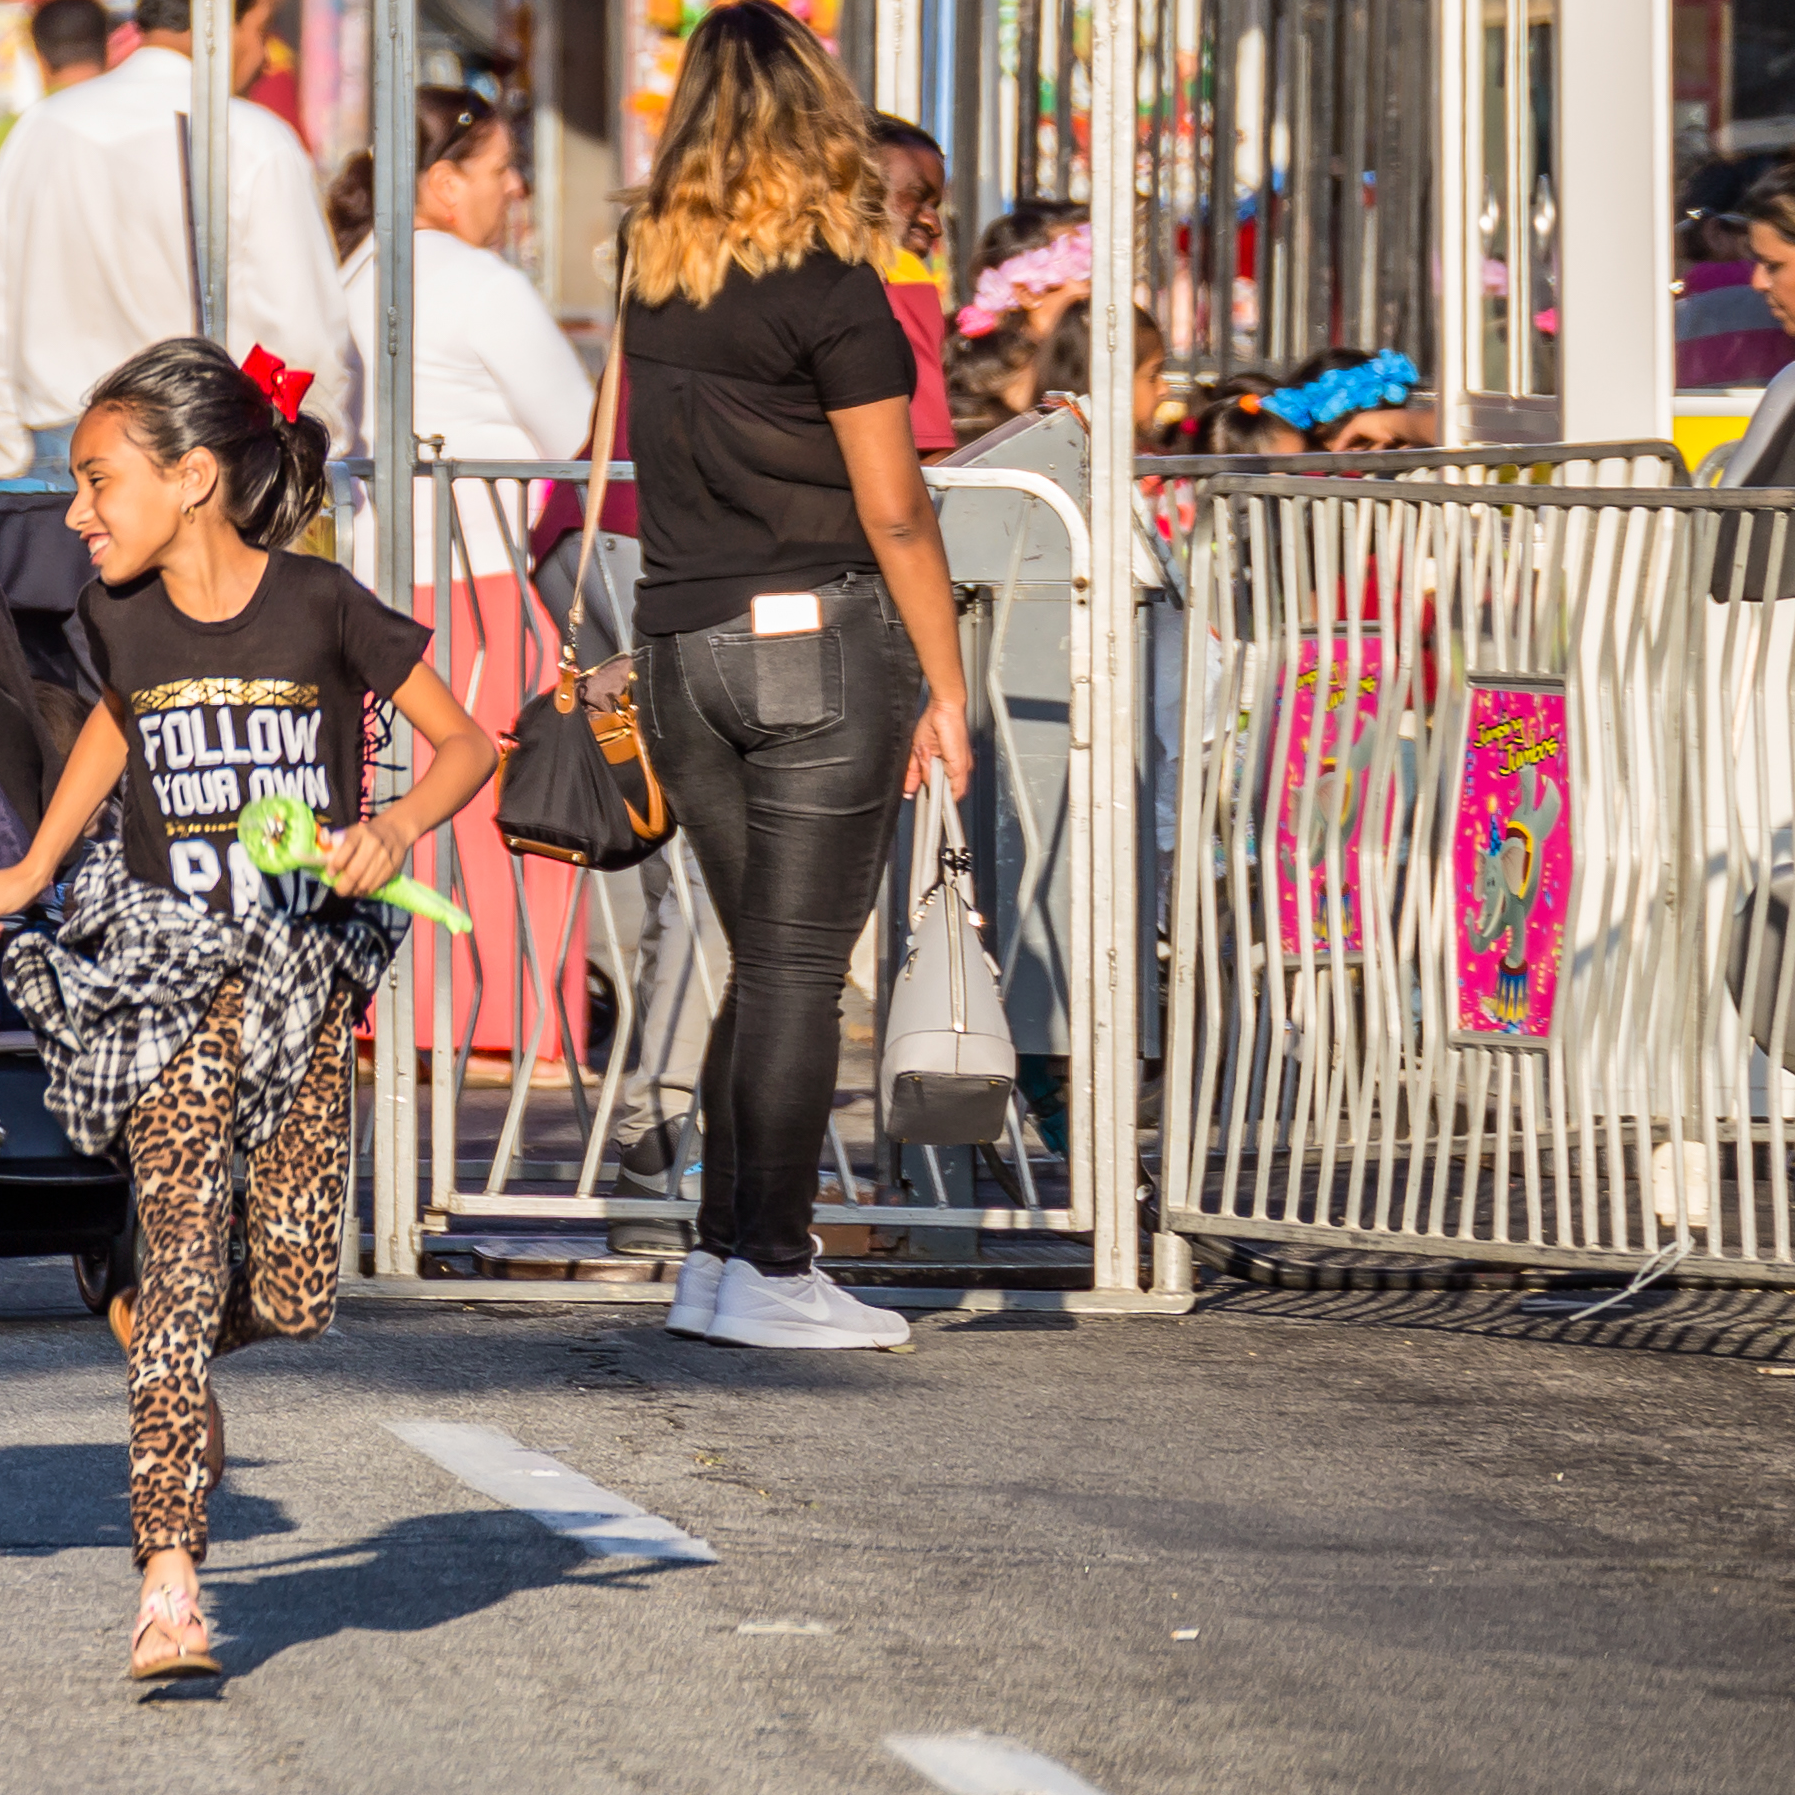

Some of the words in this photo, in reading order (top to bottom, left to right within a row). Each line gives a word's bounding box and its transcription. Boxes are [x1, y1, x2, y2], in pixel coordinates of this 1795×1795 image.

[138, 706, 321, 771] FOLLOW
[1474, 716, 1524, 752] Jumping
[1499, 731, 1559, 776] Jumbos
[153, 767, 241, 818] YOUR
[247, 764, 330, 810] OWN
